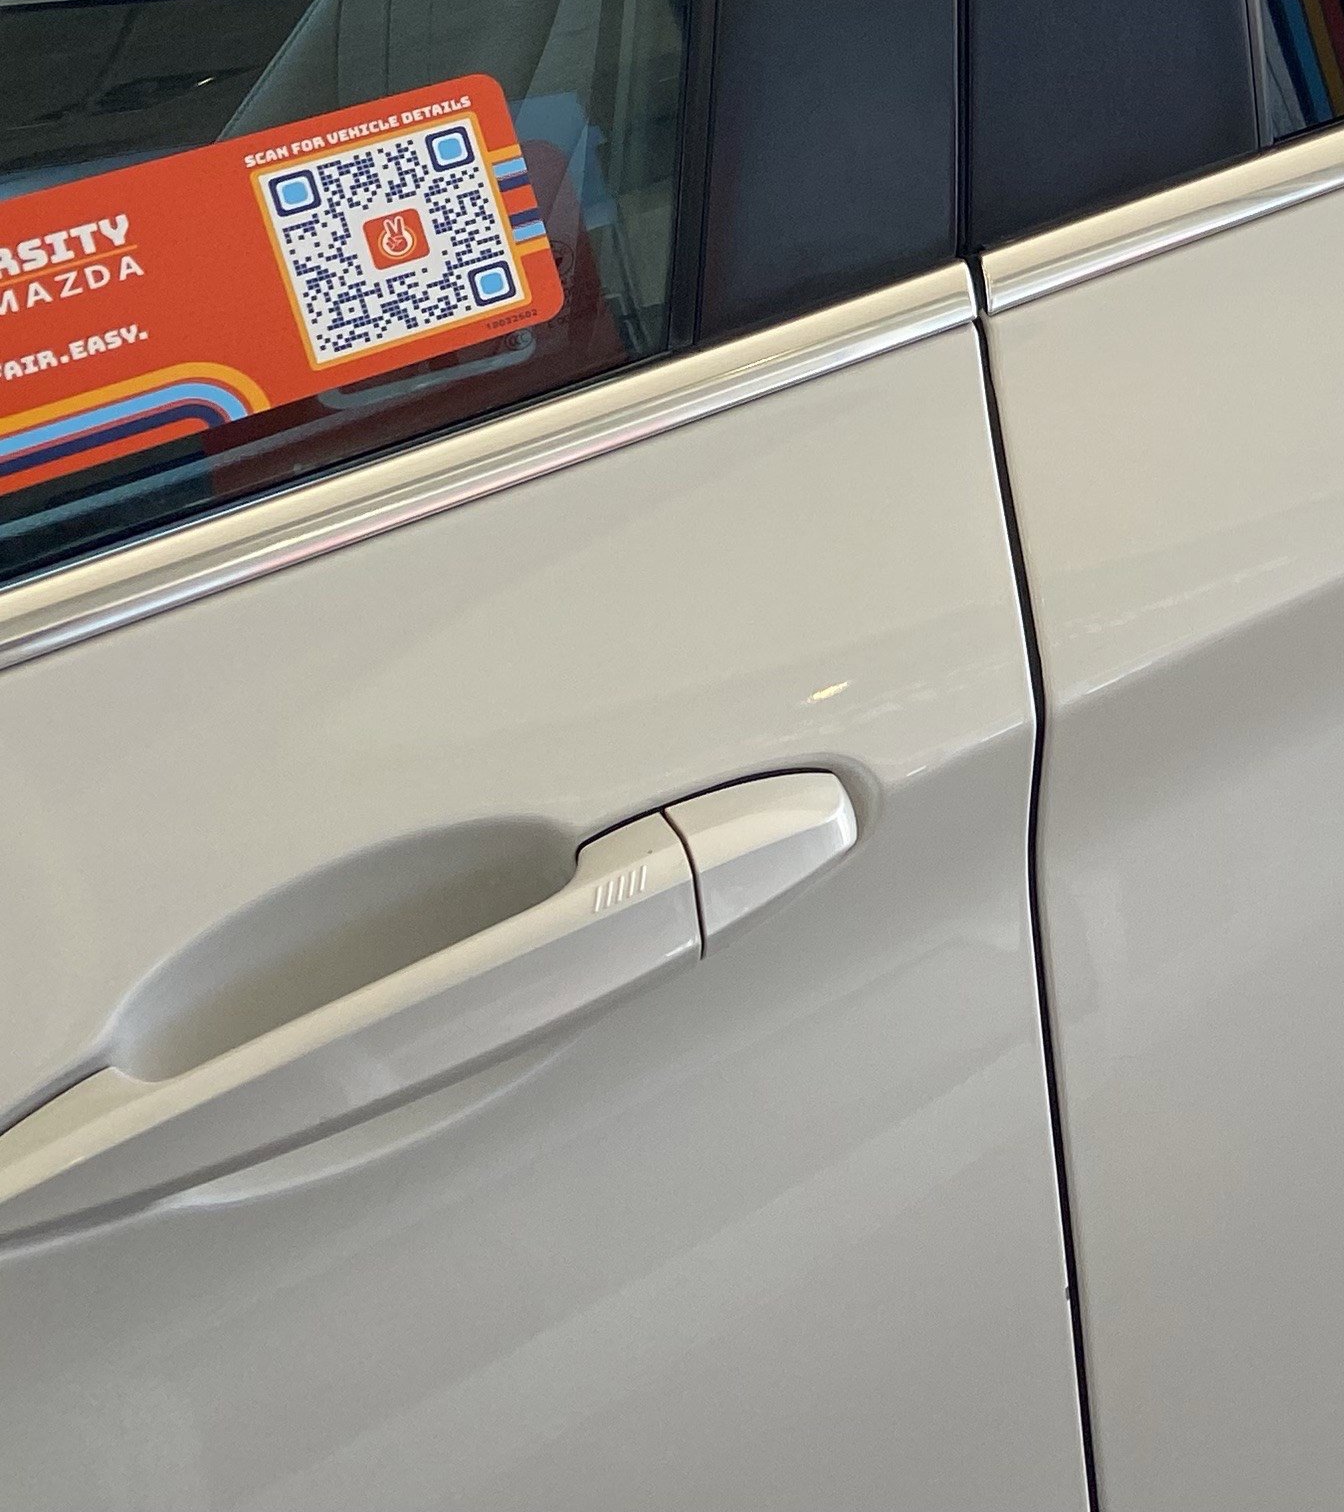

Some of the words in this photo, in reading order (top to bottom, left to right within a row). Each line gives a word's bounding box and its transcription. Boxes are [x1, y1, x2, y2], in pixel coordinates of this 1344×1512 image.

[243, 144, 290, 169] SCAN
[291, 135, 326, 156] FOR
[326, 114, 400, 146] VEHICLE
[401, 94, 472, 125] DETAILS
[0, 324, 149, 381] AIR.EASY.
